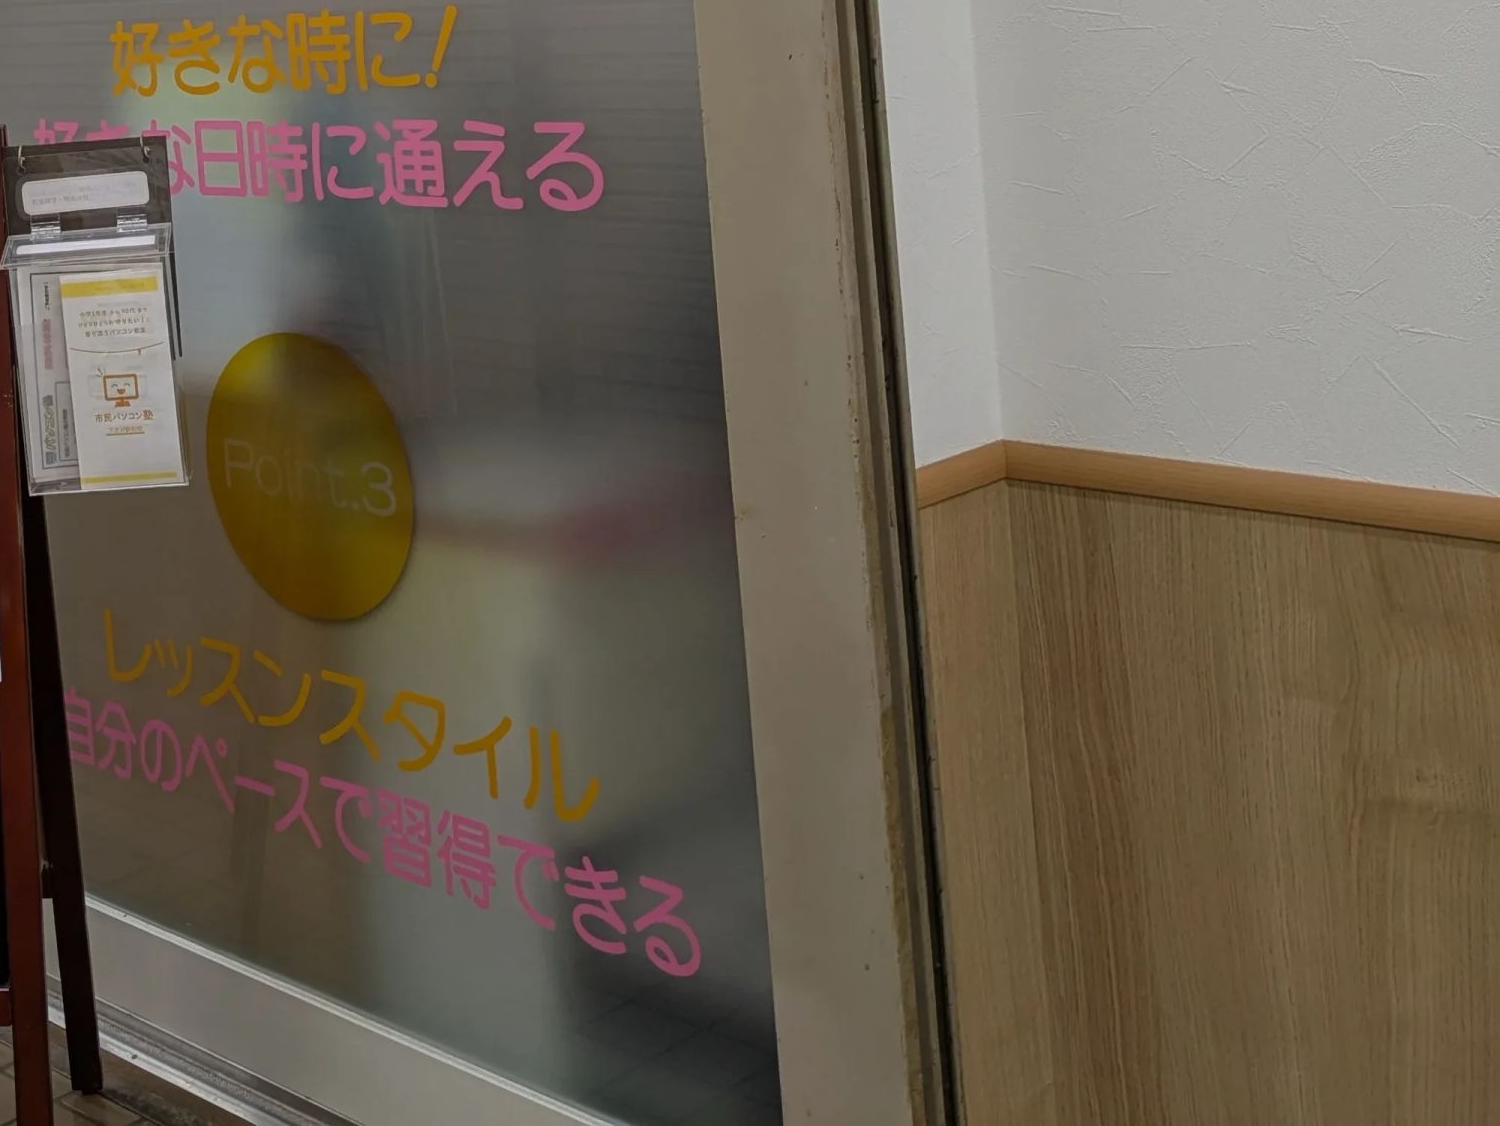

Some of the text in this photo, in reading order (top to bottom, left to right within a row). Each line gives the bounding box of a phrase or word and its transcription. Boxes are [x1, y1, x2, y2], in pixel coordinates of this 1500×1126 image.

[110, 4, 457, 96] 好きな時に!
[95, 410, 153, 423] 市民パソコン塾
[105, 608, 599, 822] レッスンスタイル
[62, 686, 701, 978] 自分のペースで習得できる
